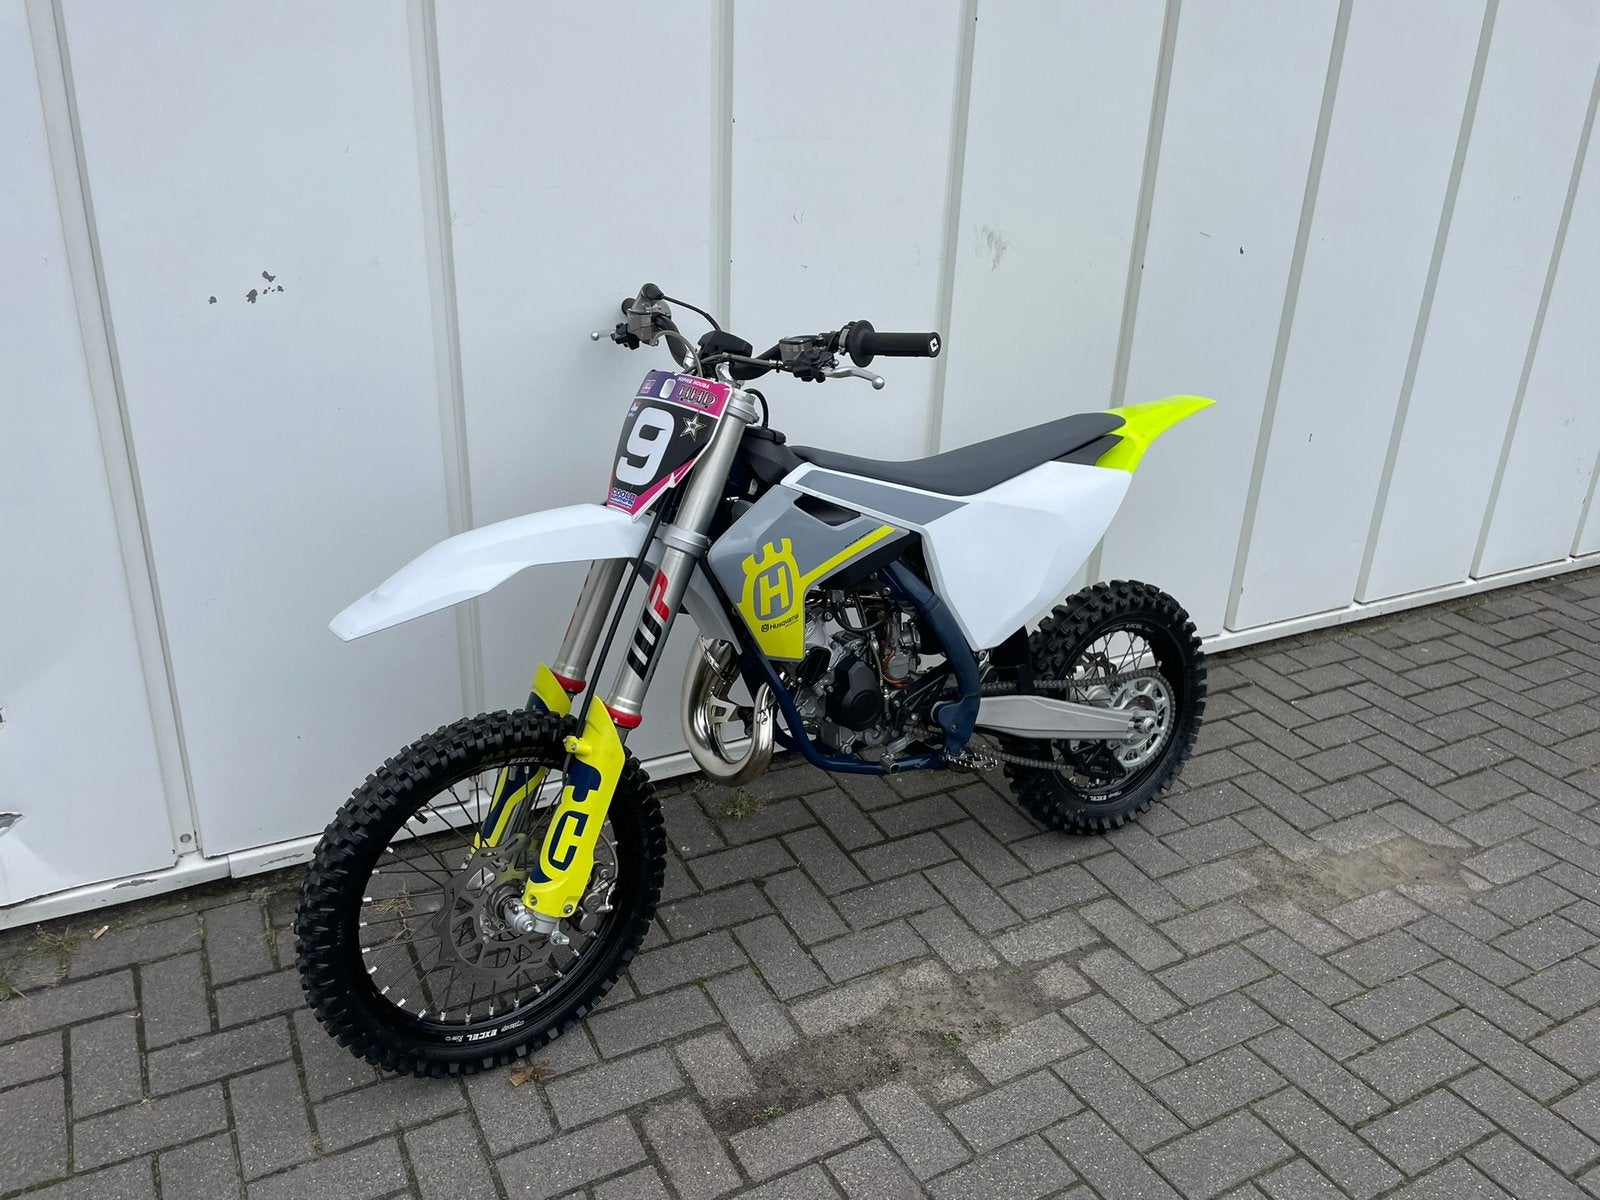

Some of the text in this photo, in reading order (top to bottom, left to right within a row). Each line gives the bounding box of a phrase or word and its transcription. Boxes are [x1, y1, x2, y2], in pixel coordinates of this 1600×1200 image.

[678, 385, 717, 406] HHD
[615, 406, 675, 486] 9
[626, 568, 671, 682] WP
[508, 756, 541, 765] EXCEL
[466, 1028, 498, 1042] EXCEL
